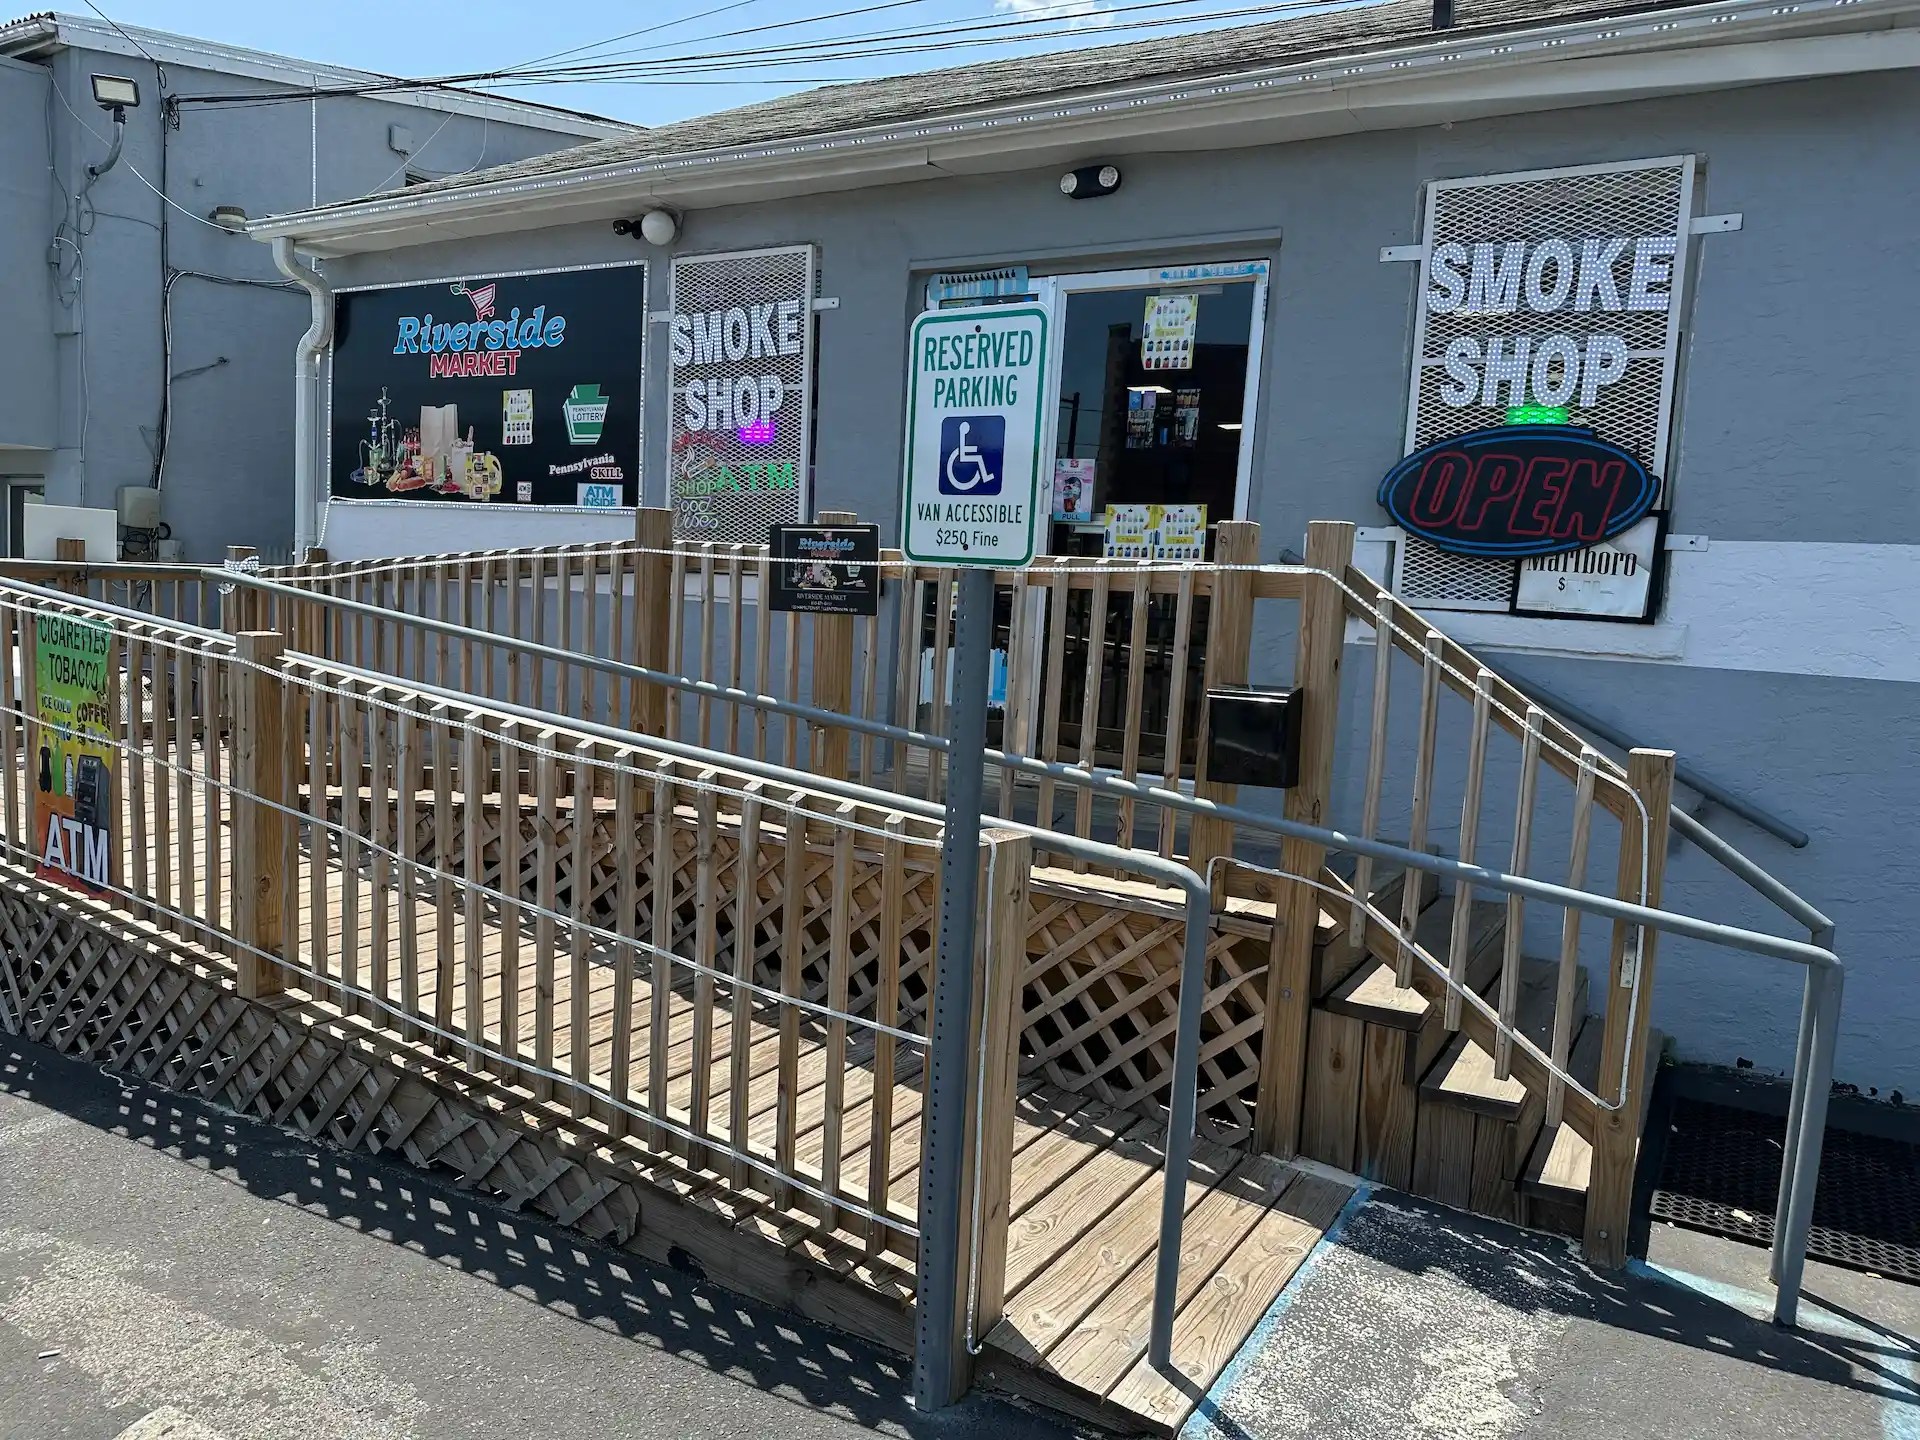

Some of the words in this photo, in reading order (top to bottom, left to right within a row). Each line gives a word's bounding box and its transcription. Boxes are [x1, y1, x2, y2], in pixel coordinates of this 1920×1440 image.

[1426, 236, 1677, 314] SMOKE
[393, 305, 566, 354] Riverside
[671, 299, 801, 367] SMOKE
[430, 349, 521, 378] MARKET
[924, 330, 1034, 372] RESERVED
[1440, 333, 1628, 408] SHOP
[685, 374, 784, 432] SHOP
[933, 374, 1018, 409] PARKING
[572, 412, 605, 422] LOTTERY
[549, 453, 615, 476] Pennsylvania
[591, 467, 623, 480] SKILL
[715, 463, 795, 492] ATM
[585, 485, 614, 498] ATM
[677, 480, 716, 495] SHOP
[1409, 451, 1627, 542] OPEN
[583, 498, 617, 507] INSIDE
[917, 503, 940, 522] VAN
[945, 504, 1023, 524] ACCESSIBLE
[1061, 513, 1080, 521] PULL
[798, 537, 856, 551] Riverside
[936, 530, 967, 547] $250
[973, 531, 999, 547] Fine
[796, 592, 822, 601] RIVERSIDE
[40, 614, 108, 656] CIGARETTES
[48, 653, 99, 692] TOBACCO
[41, 695, 53, 709] ICE
[53, 698, 72, 714] COLD
[76, 702, 111, 732] COFFEE
[43, 813, 109, 886] ATM
